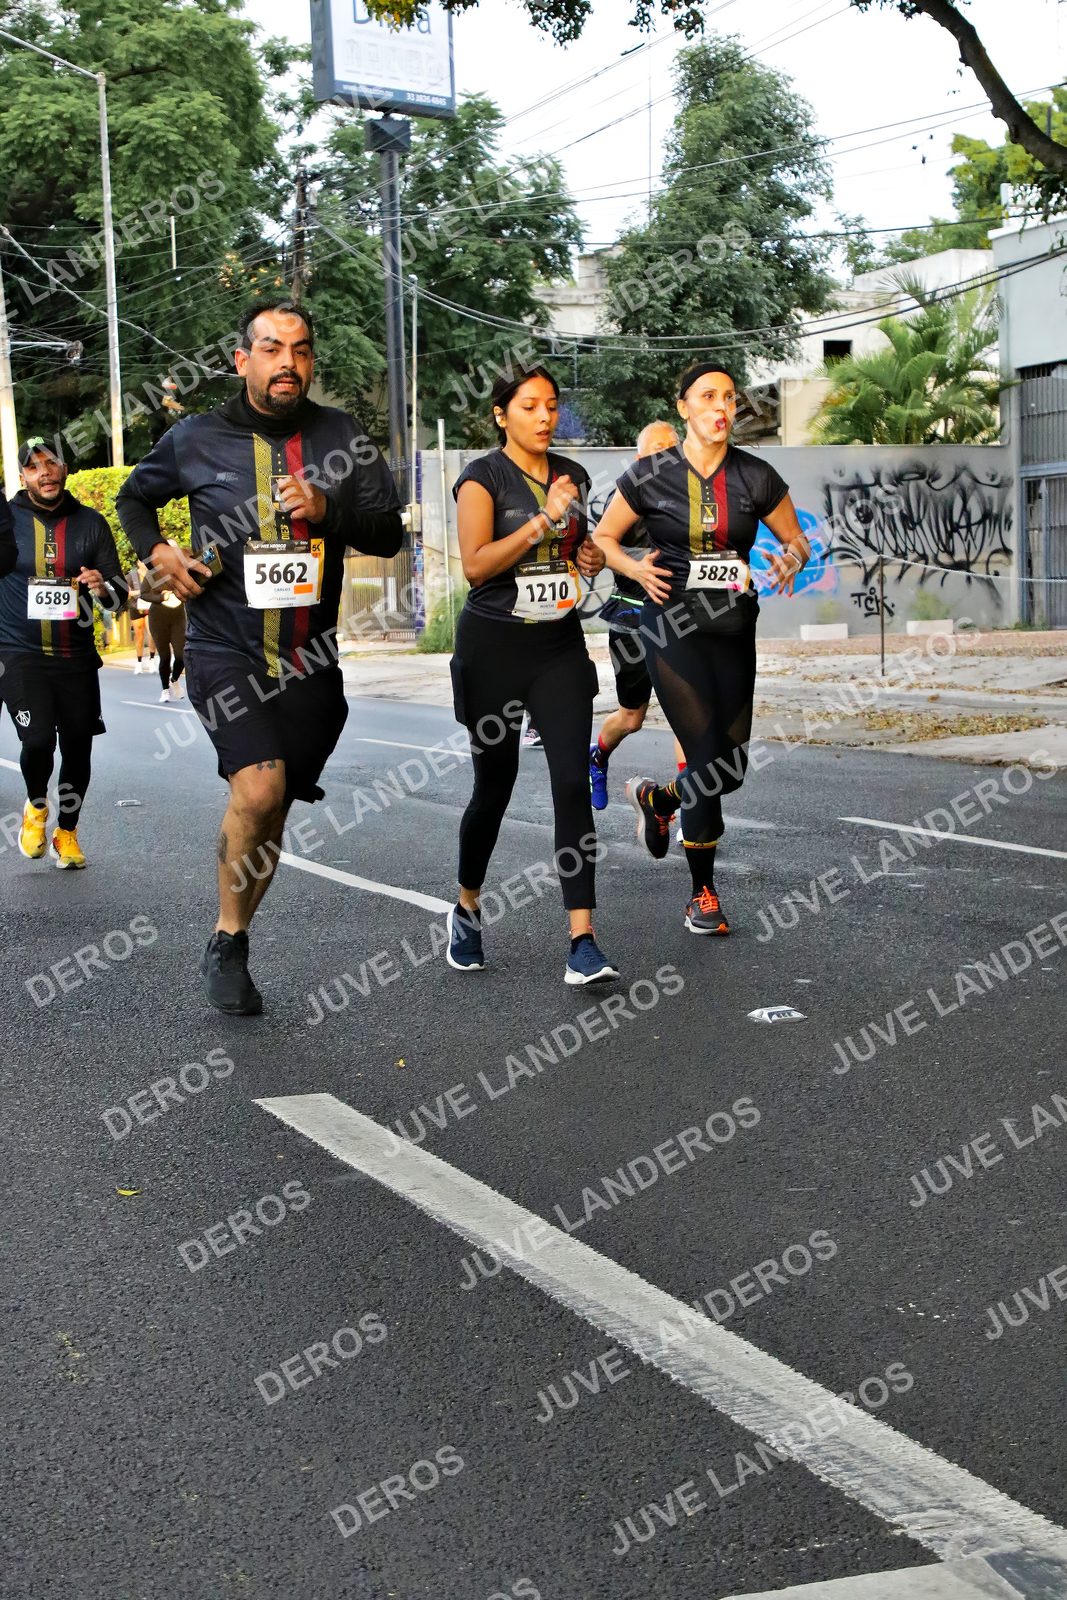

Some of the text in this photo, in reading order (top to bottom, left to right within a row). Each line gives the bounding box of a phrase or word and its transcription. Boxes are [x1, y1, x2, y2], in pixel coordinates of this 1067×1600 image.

[255, 562, 308, 585] 5662
[697, 565, 739, 582] 5828
[35, 591, 70, 606] 6589
[526, 581, 568, 602] 1210
